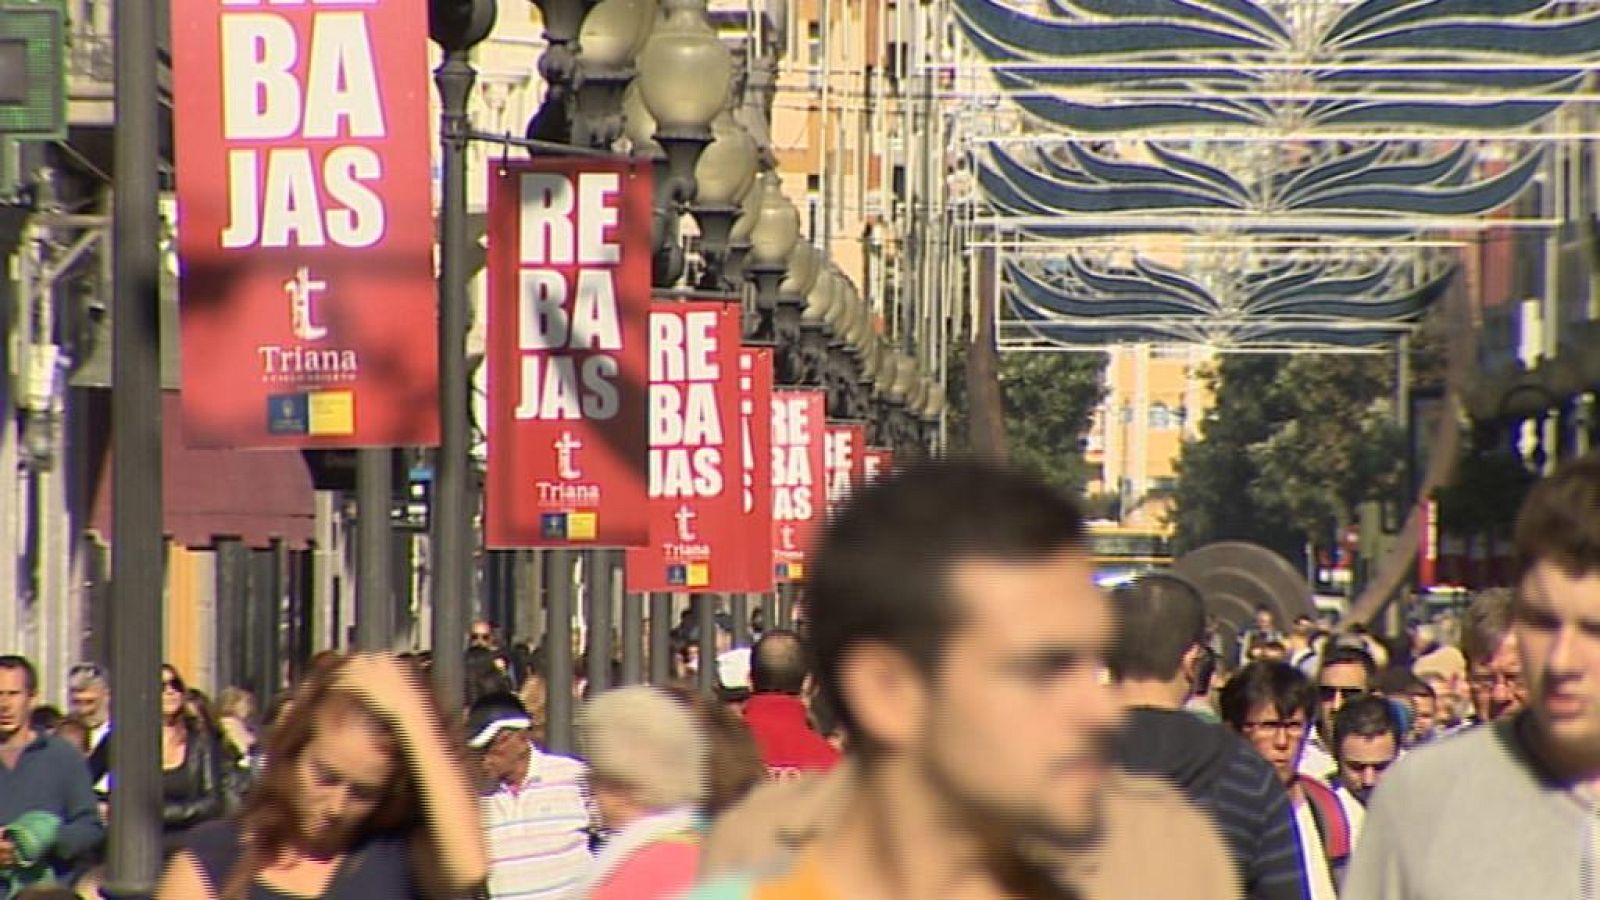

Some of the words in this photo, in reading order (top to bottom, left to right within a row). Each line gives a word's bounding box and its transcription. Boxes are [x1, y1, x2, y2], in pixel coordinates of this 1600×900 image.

[220, 11, 385, 139] BA
[221, 146, 384, 248] JAS
[519, 172, 621, 264] RE
[519, 269, 622, 349] BA
[257, 346, 357, 373] Triana
[649, 311, 720, 381] RE
[515, 354, 620, 420] JAS
[649, 382, 724, 446] BA
[535, 482, 600, 502] Triana
[773, 486, 812, 520] AS
